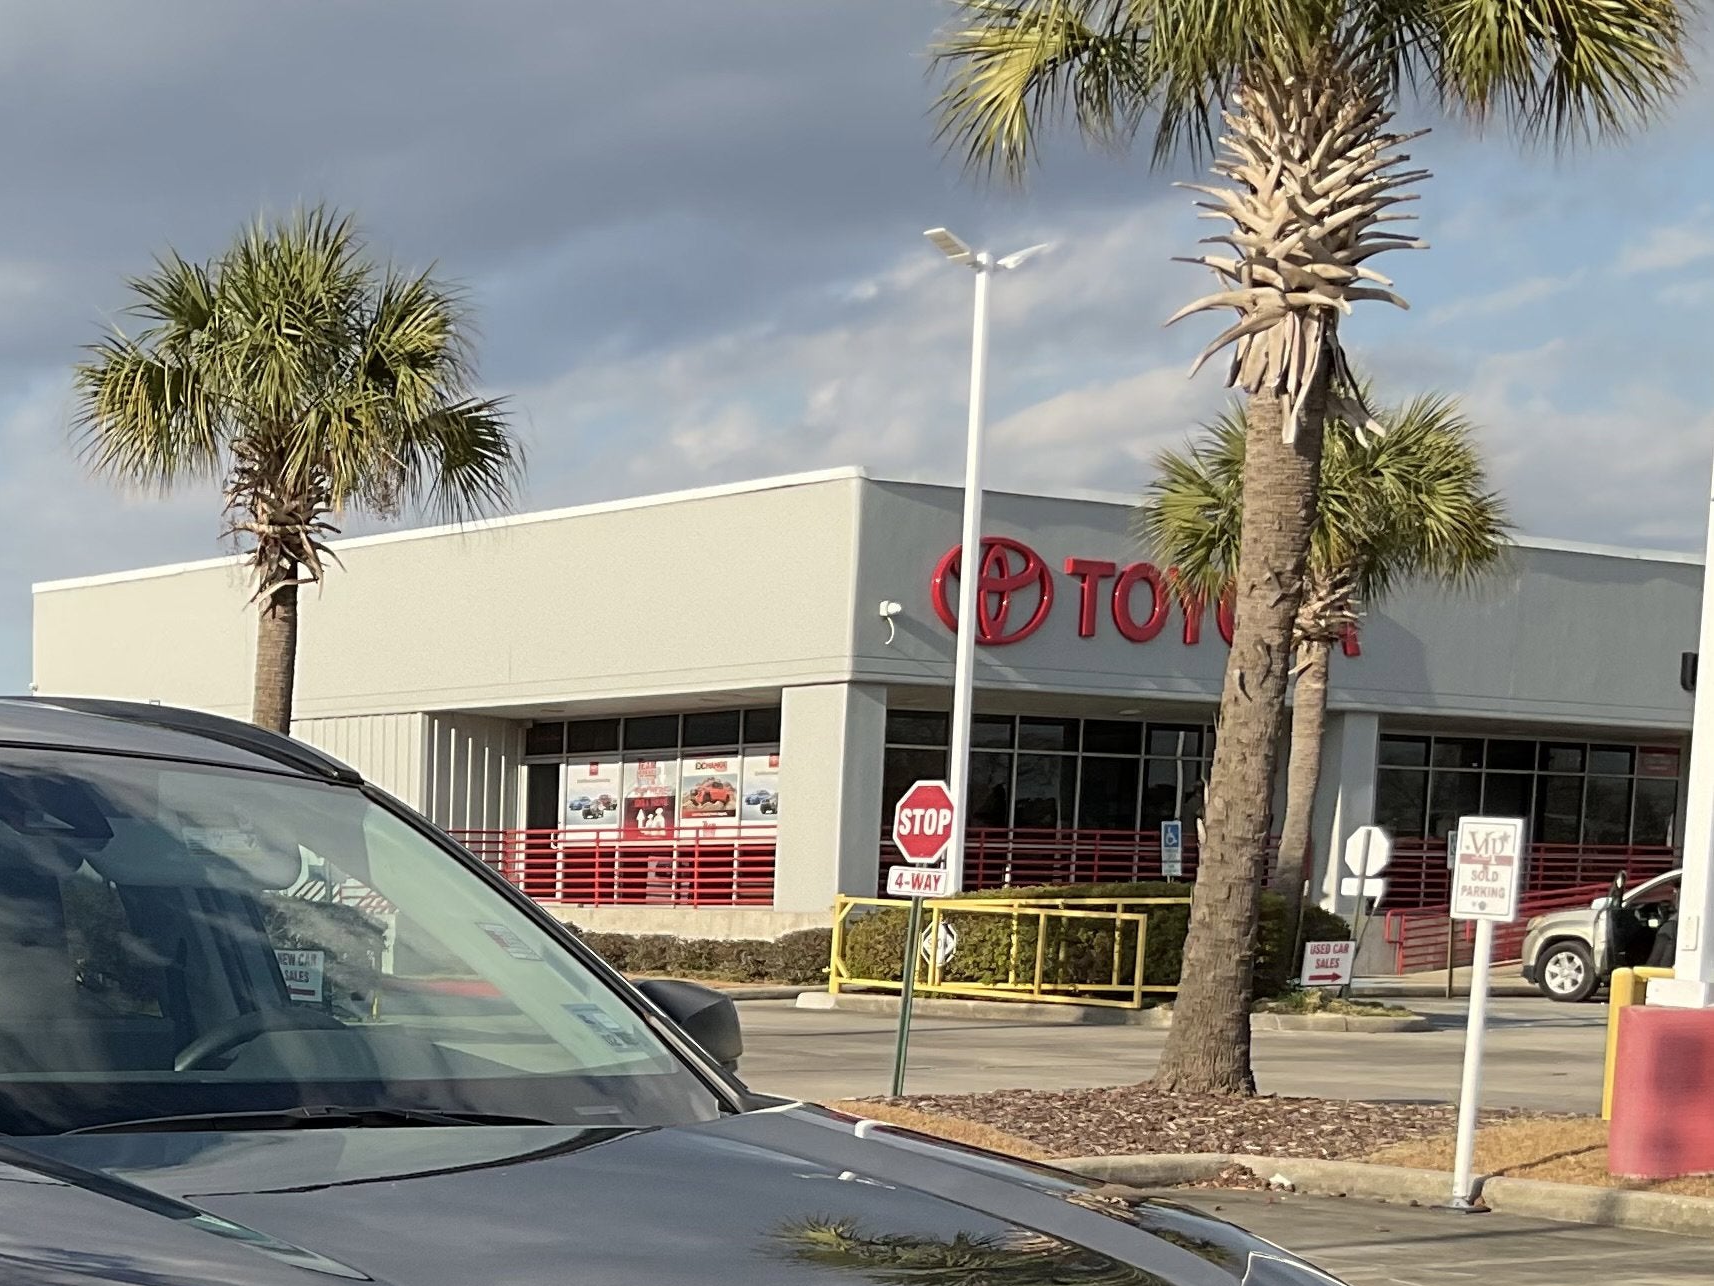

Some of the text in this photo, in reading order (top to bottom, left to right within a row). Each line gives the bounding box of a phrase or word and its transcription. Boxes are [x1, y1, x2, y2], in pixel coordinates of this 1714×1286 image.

[1064, 556, 1361, 657] TOY
[899, 808, 951, 836] STOP
[894, 872, 942, 892] 4-WAY
[1471, 870, 1499, 882] SOLD
[1460, 885, 1506, 899] PARKING
[1310, 943, 1349, 955] USED CAR
[298, 953, 317, 967] CAR
[1315, 957, 1340, 969] SALES
[285, 970, 310, 983] SALES
